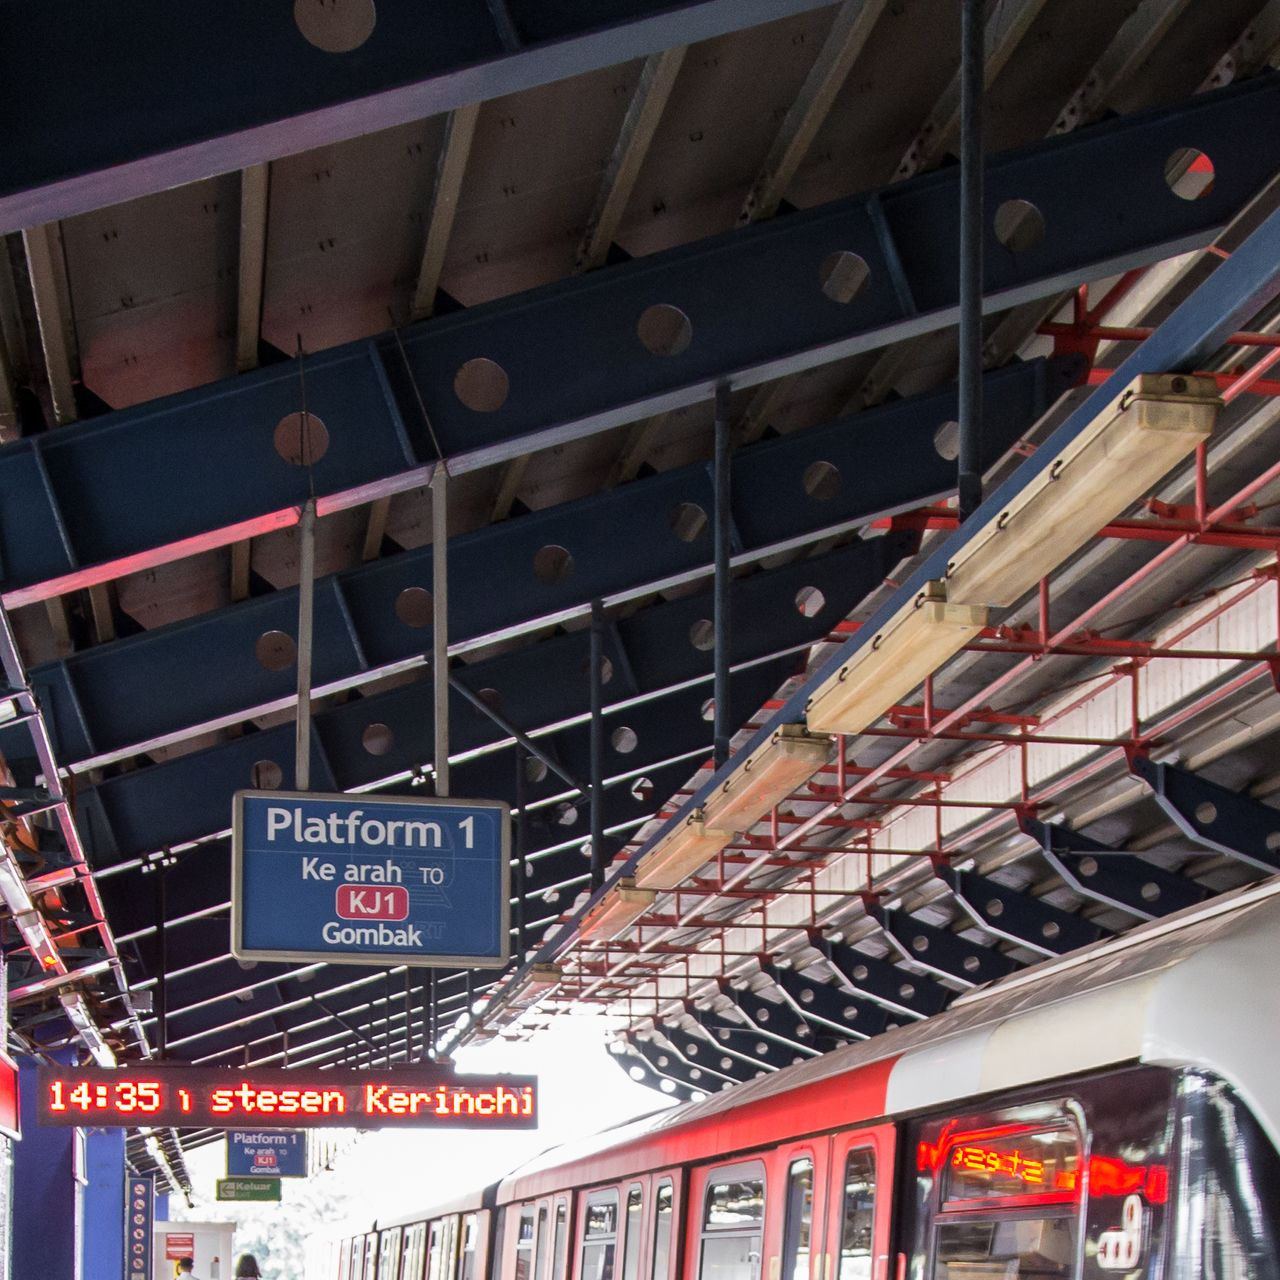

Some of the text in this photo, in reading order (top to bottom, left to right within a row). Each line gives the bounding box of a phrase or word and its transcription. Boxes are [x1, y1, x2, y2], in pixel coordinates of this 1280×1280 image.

[267, 807, 474, 849] Platform 1
[302, 857, 444, 885] Ke arah TO
[349, 890, 395, 914] KJ1
[322, 921, 423, 947] Gombak
[50, 1080, 160, 1112] 14:35
[212, 1083, 345, 1113] stesen
[366, 1085, 532, 1114] Kerinchi
[234, 1133, 297, 1144] Platform 1
[244, 1147, 255, 1155] Ke
